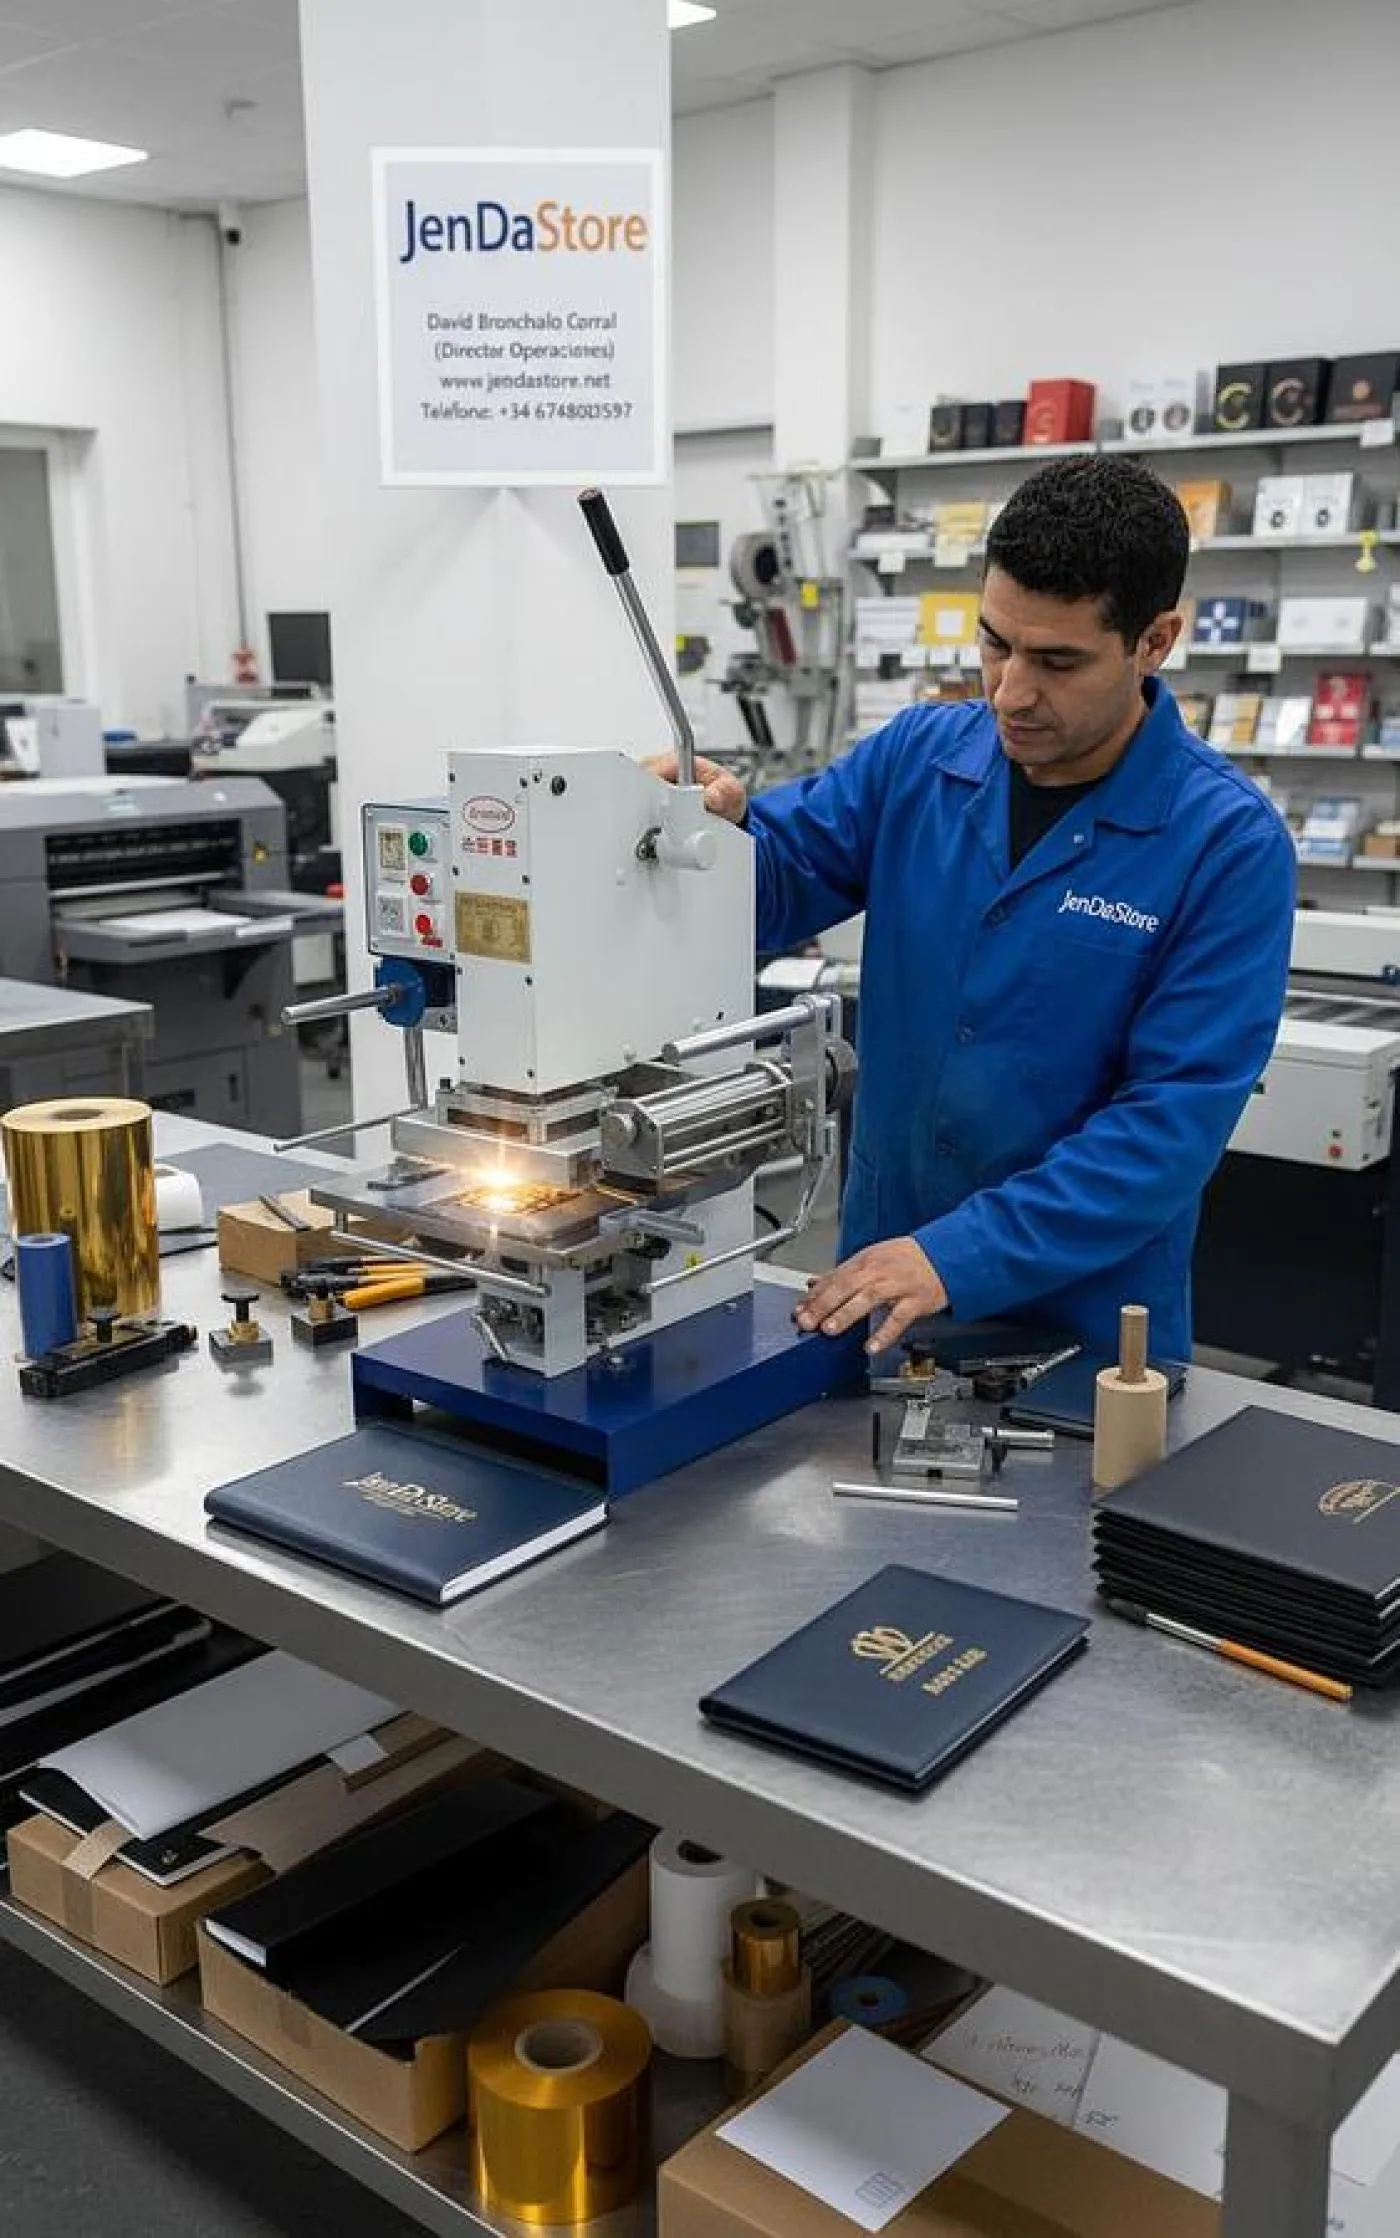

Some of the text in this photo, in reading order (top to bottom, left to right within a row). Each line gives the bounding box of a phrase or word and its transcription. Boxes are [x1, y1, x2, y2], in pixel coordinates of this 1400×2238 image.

[399, 199, 649, 264] JenDaStore
[427, 312, 473, 330] David
[499, 401, 531, 419] +34
